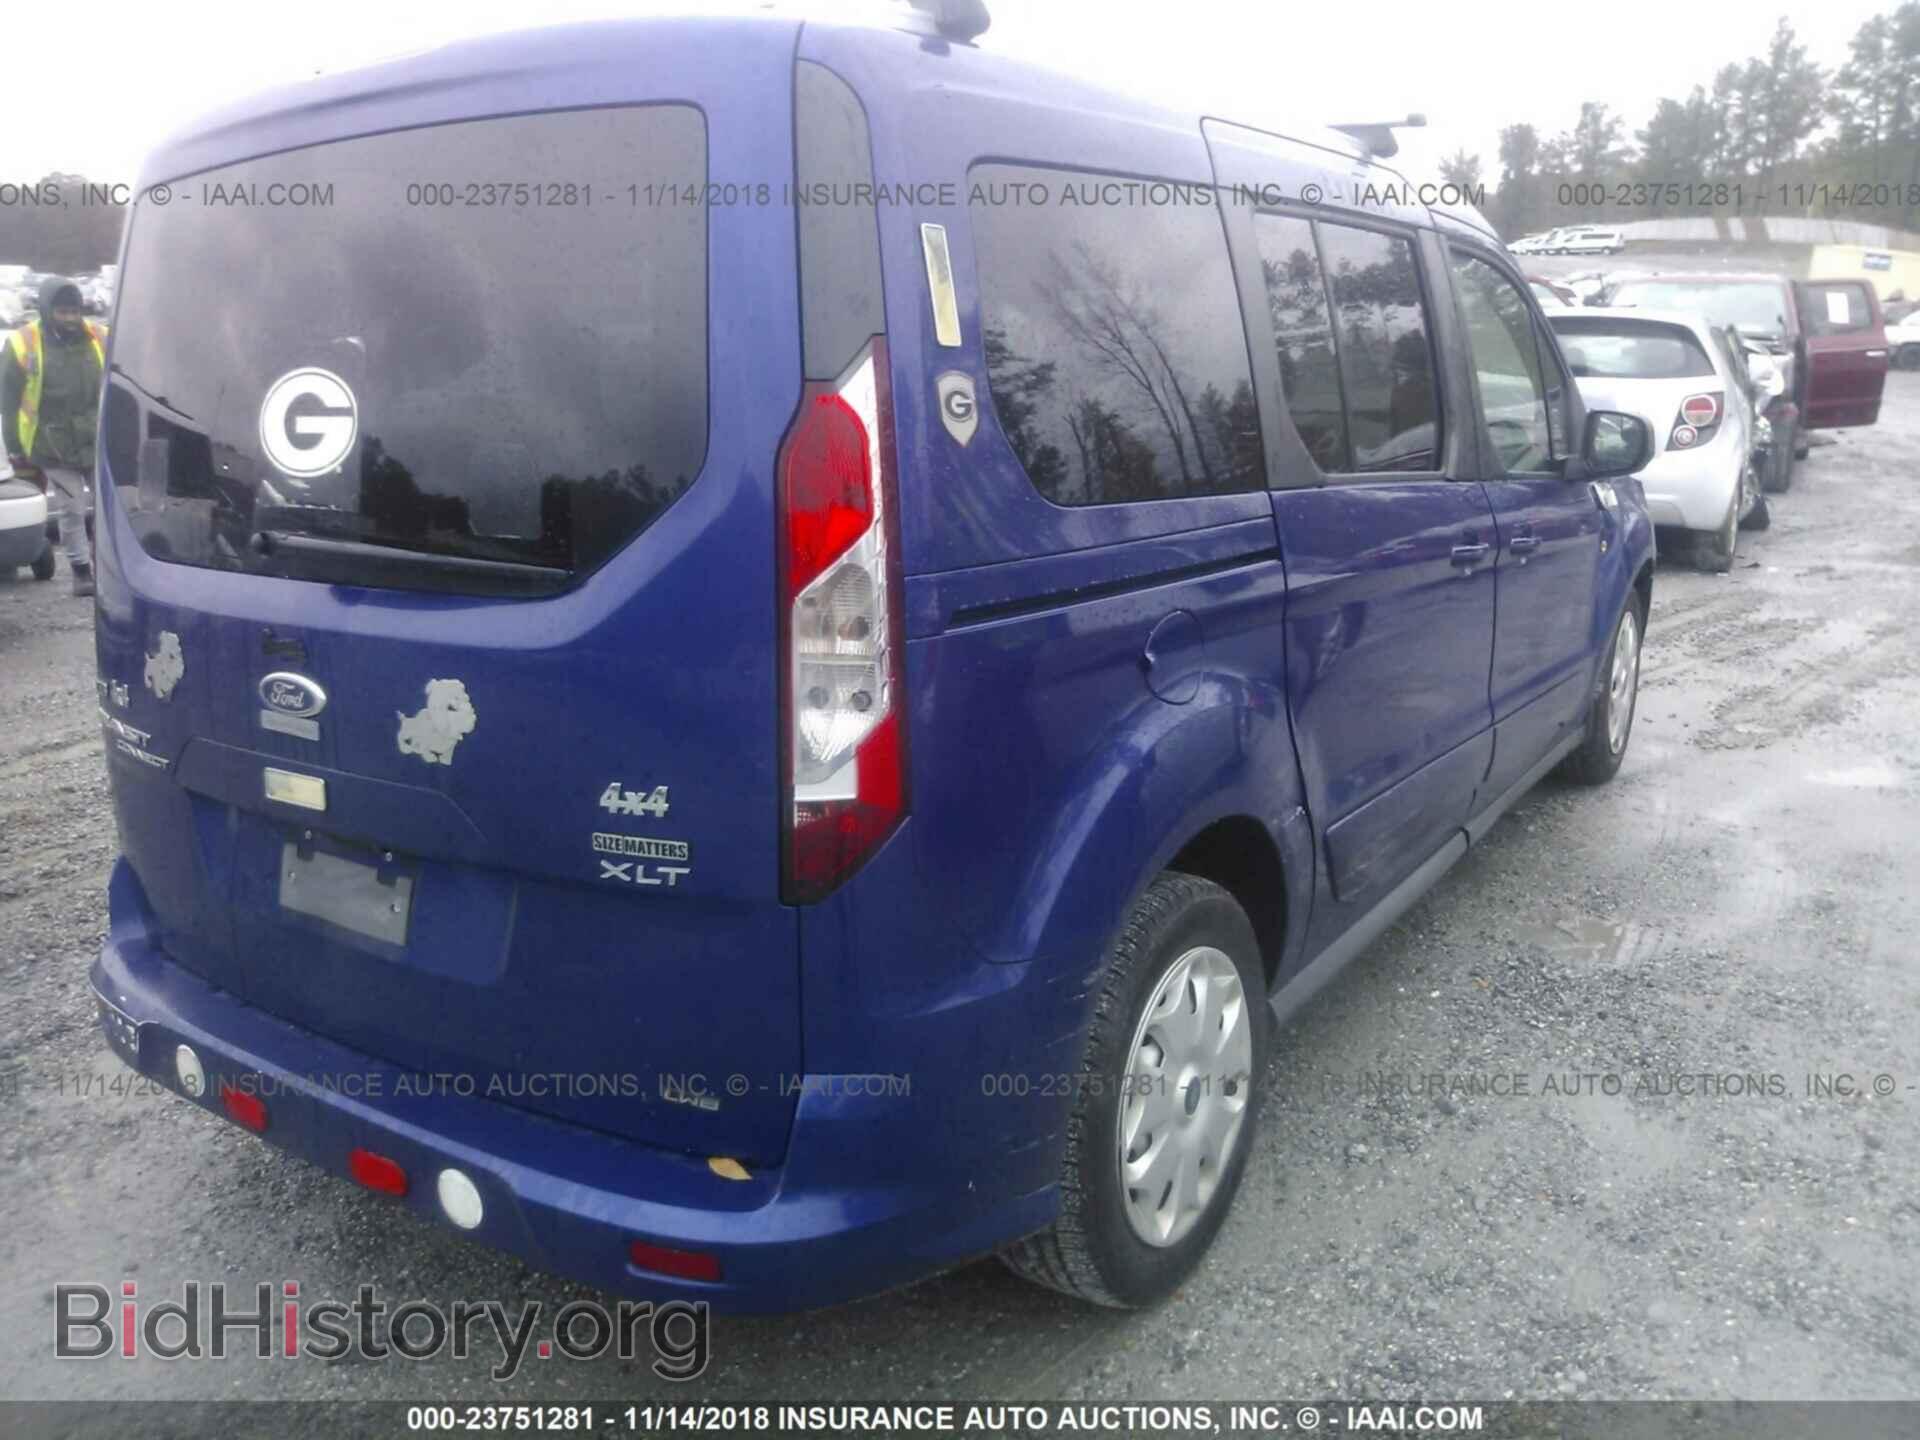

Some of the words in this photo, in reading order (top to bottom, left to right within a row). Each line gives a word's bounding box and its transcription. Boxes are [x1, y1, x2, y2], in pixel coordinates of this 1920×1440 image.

[945, 390, 974, 420] G
[259, 366, 358, 478] G
[270, 680, 305, 708] Ford
[599, 782, 670, 818] 4x4
[594, 834, 623, 852] SIZE
[625, 838, 687, 859] MATTERS
[600, 860, 691, 886] XLT
